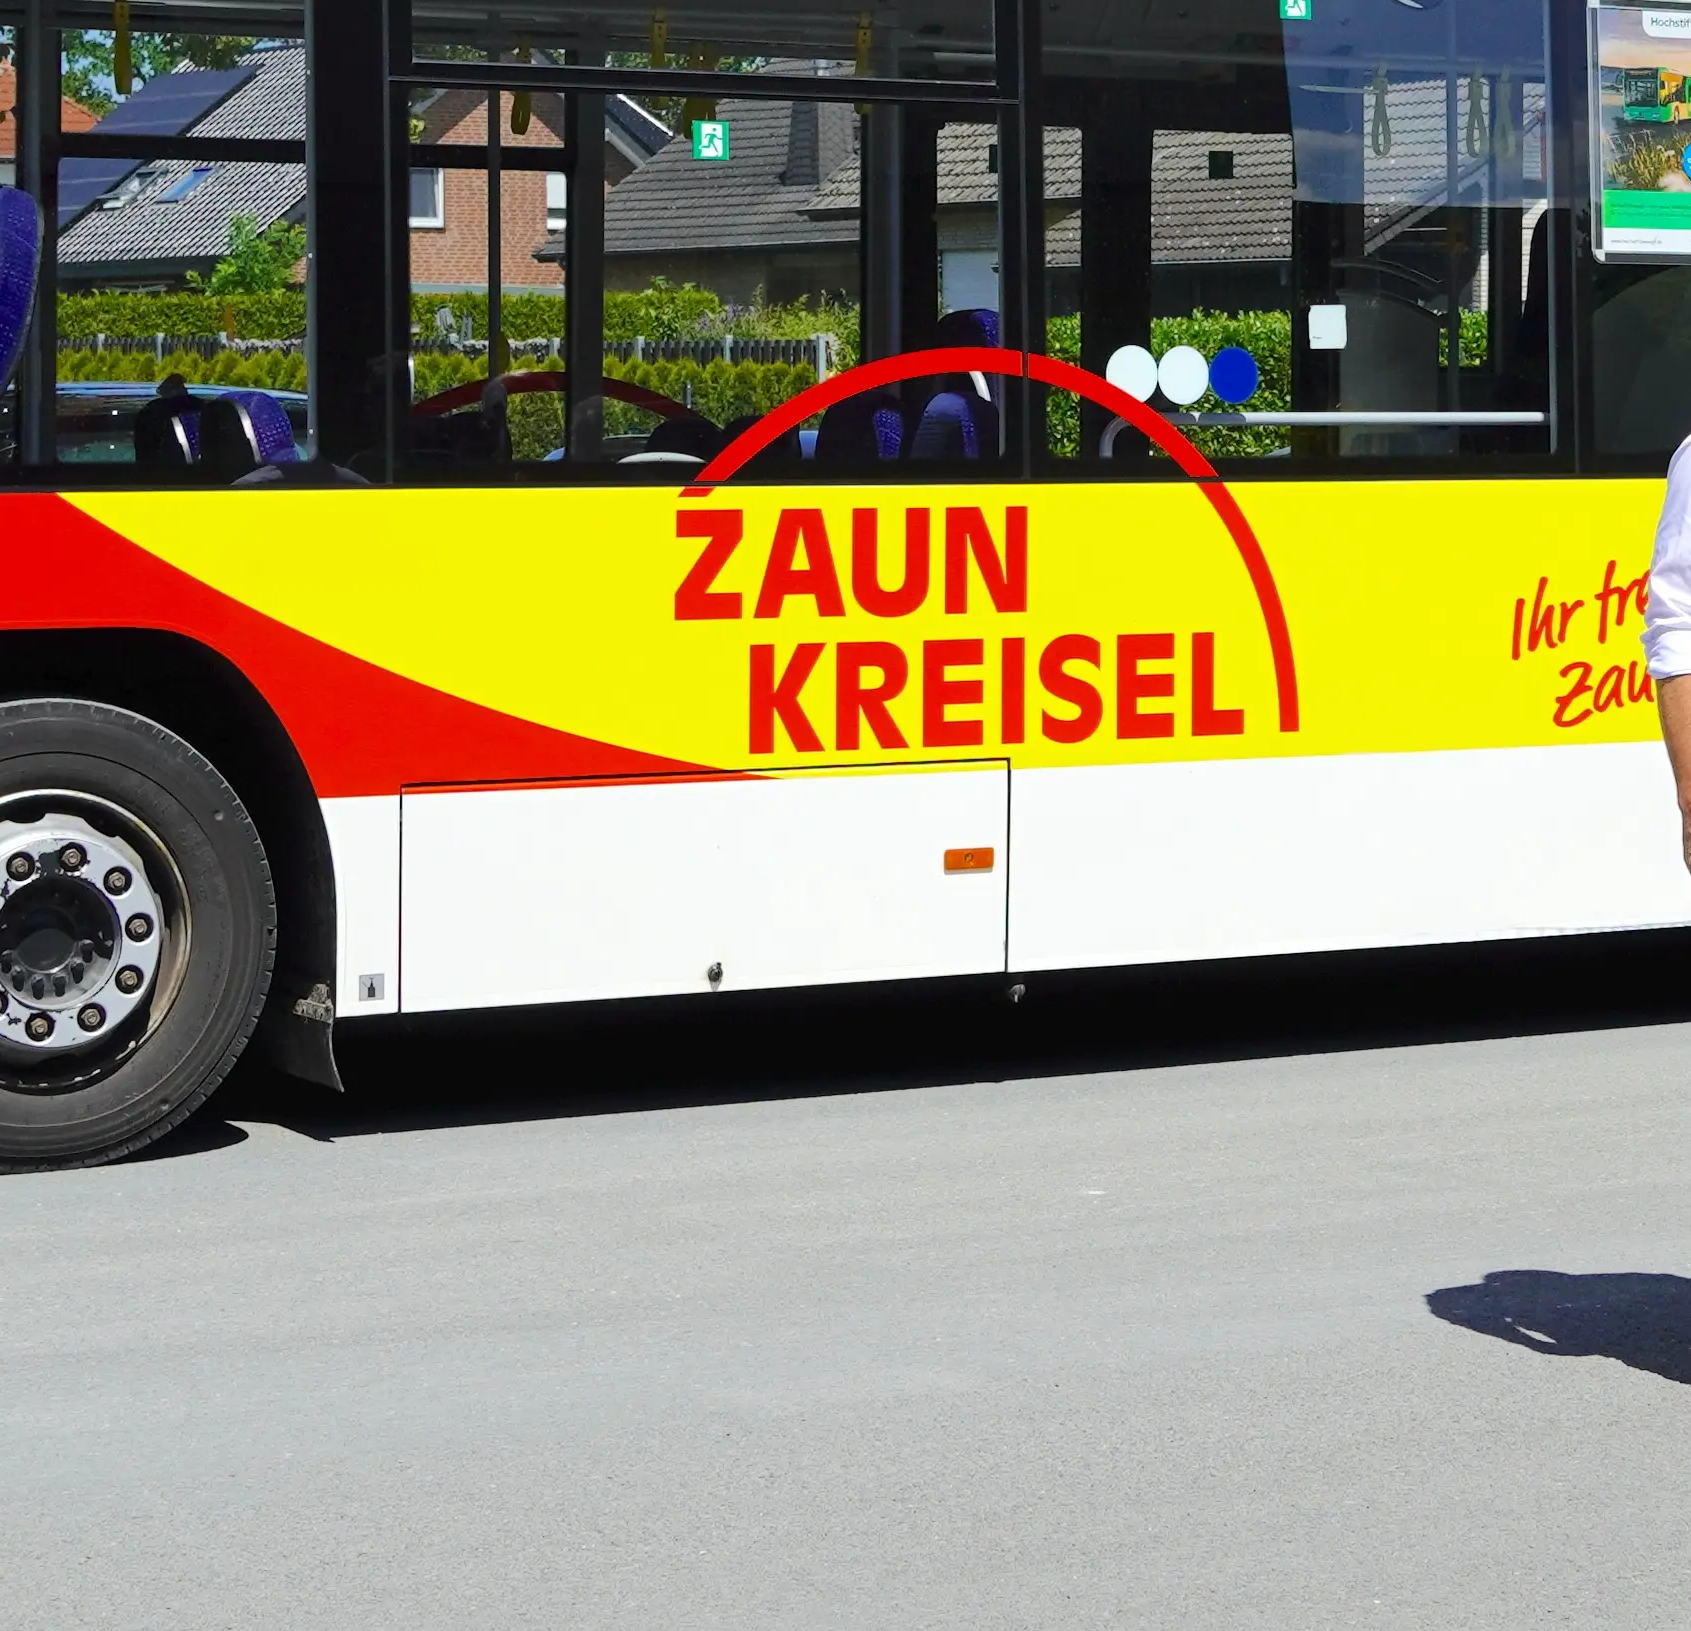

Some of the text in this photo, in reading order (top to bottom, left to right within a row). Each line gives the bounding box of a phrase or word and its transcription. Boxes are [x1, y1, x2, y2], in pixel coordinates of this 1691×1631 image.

[673, 505, 1028, 621] ZAUN
[1511, 576, 1585, 661] Ihr
[748, 631, 1245, 755] KREISEL
[1553, 661, 1654, 728] Zau
